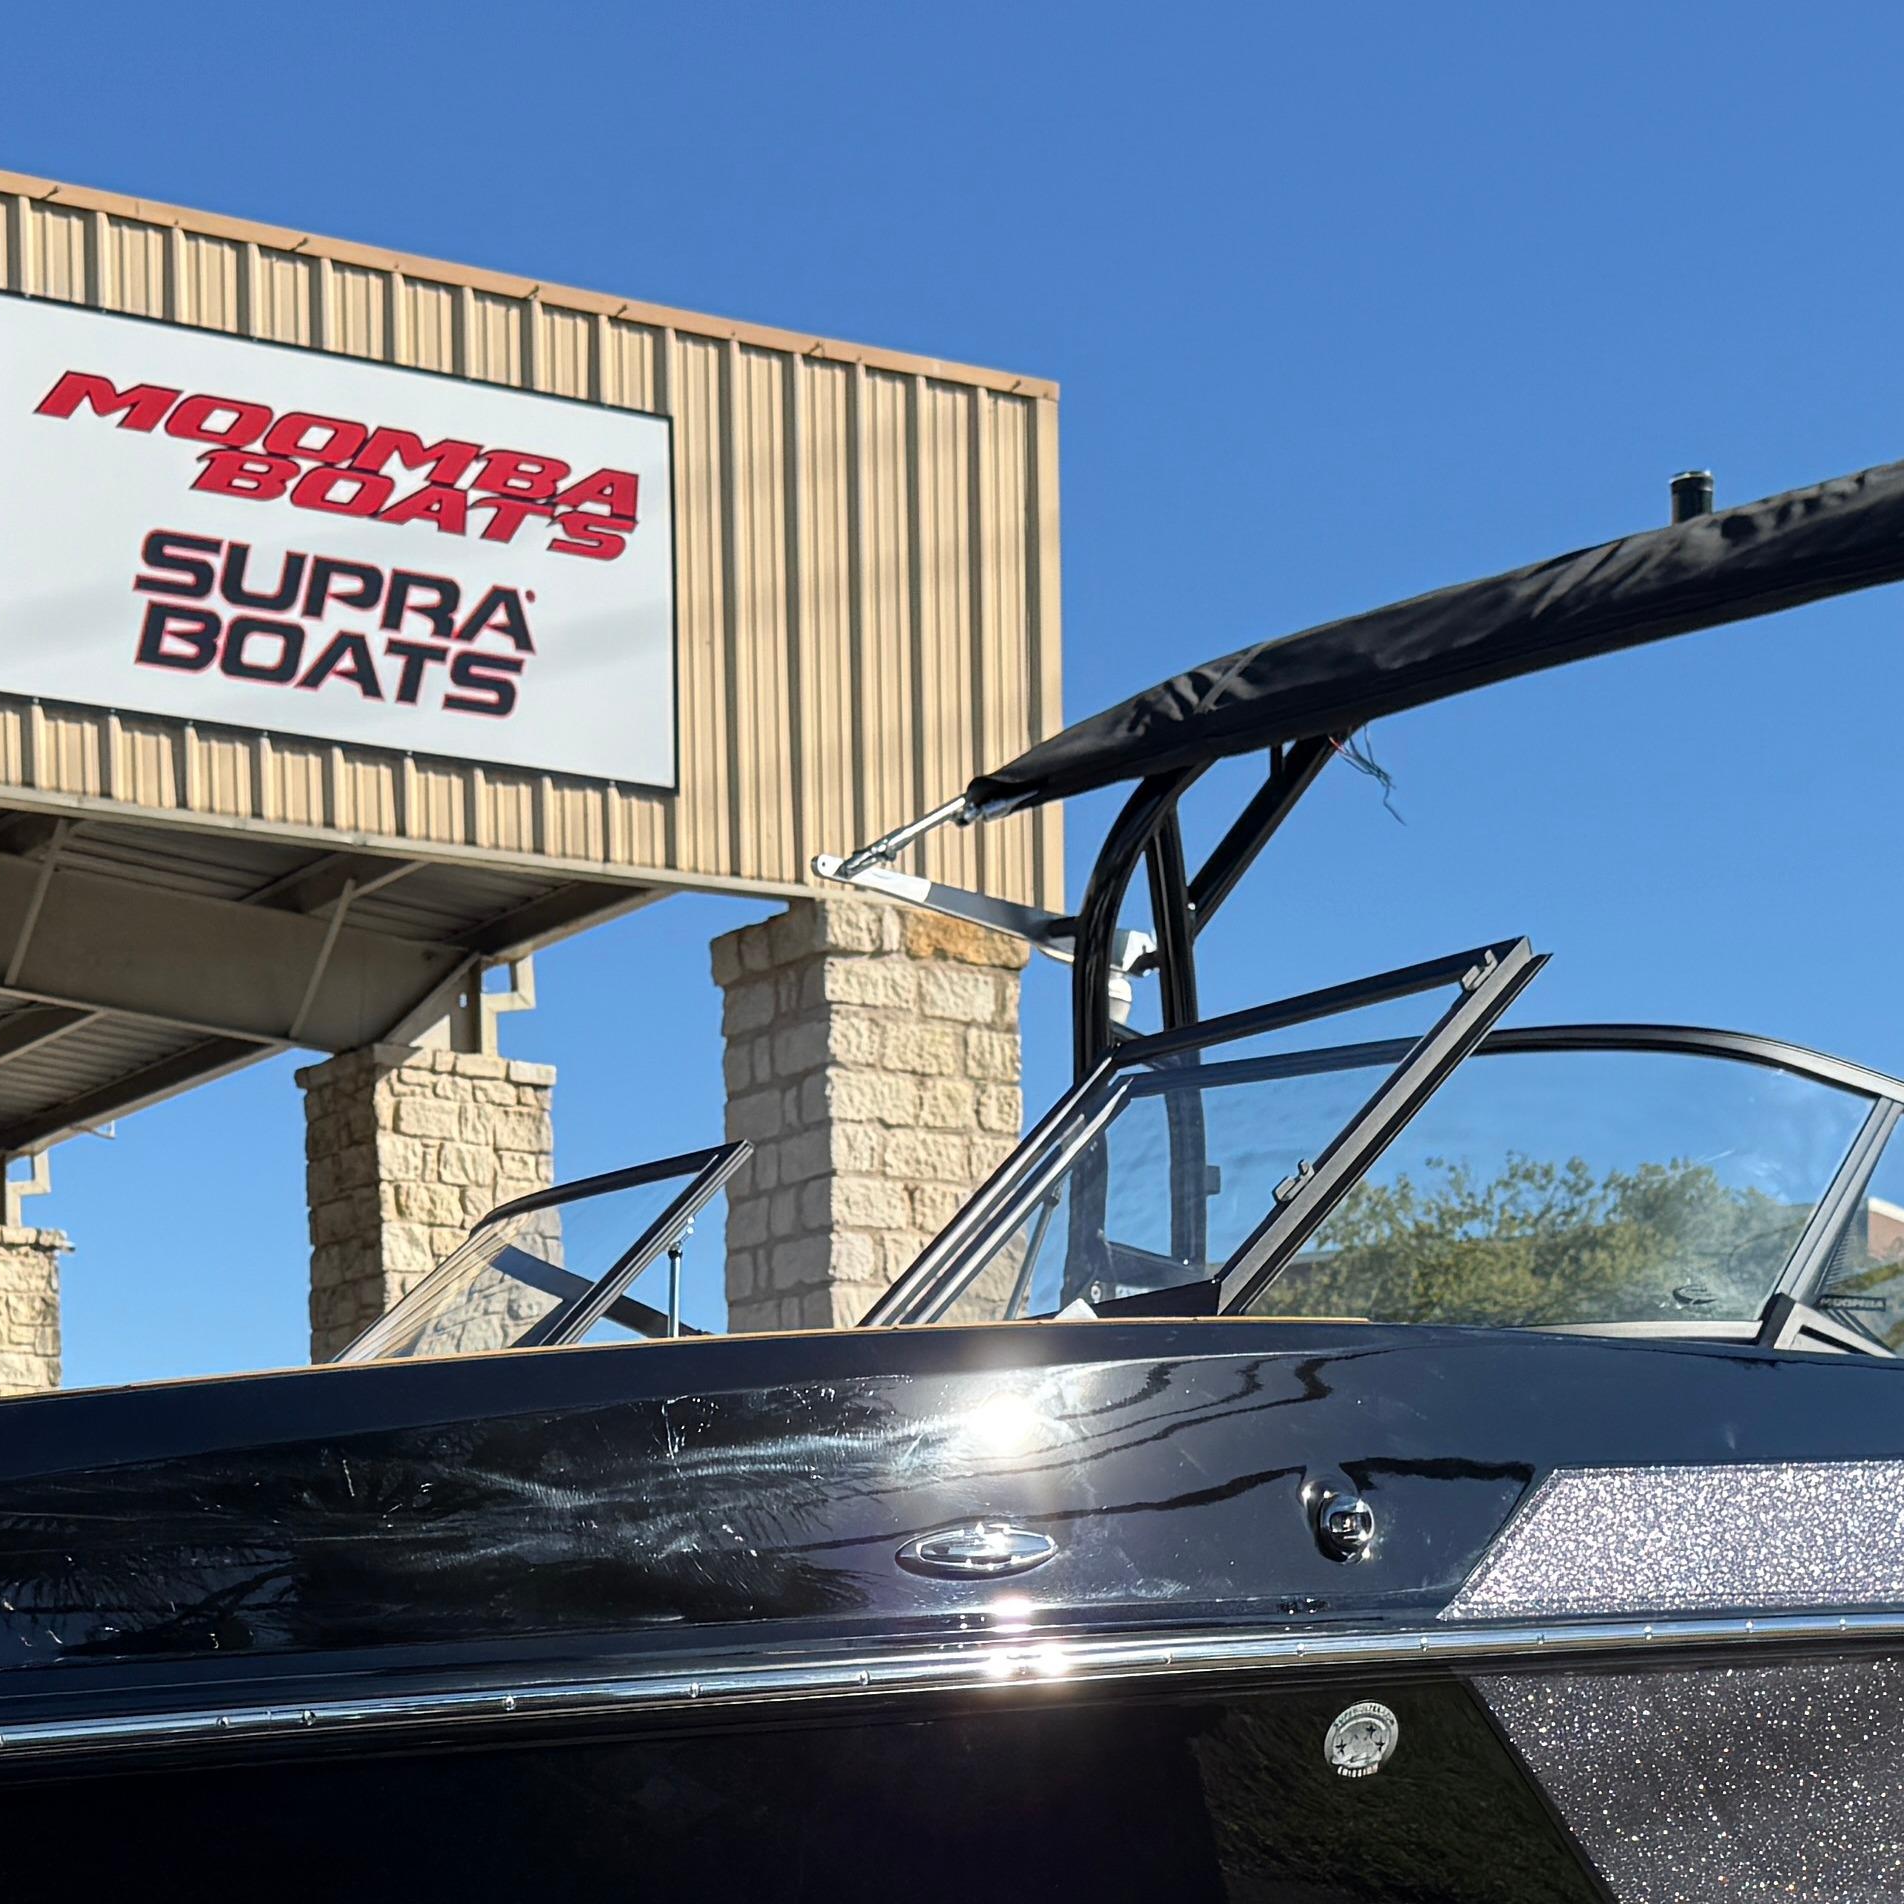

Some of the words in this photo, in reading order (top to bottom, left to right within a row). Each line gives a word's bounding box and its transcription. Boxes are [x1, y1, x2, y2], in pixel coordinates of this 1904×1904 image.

[33, 369, 639, 517] MOOMBA
[188, 447, 638, 562] BOATS
[133, 528, 537, 654] SUPRA
[134, 602, 524, 718] BOATS
